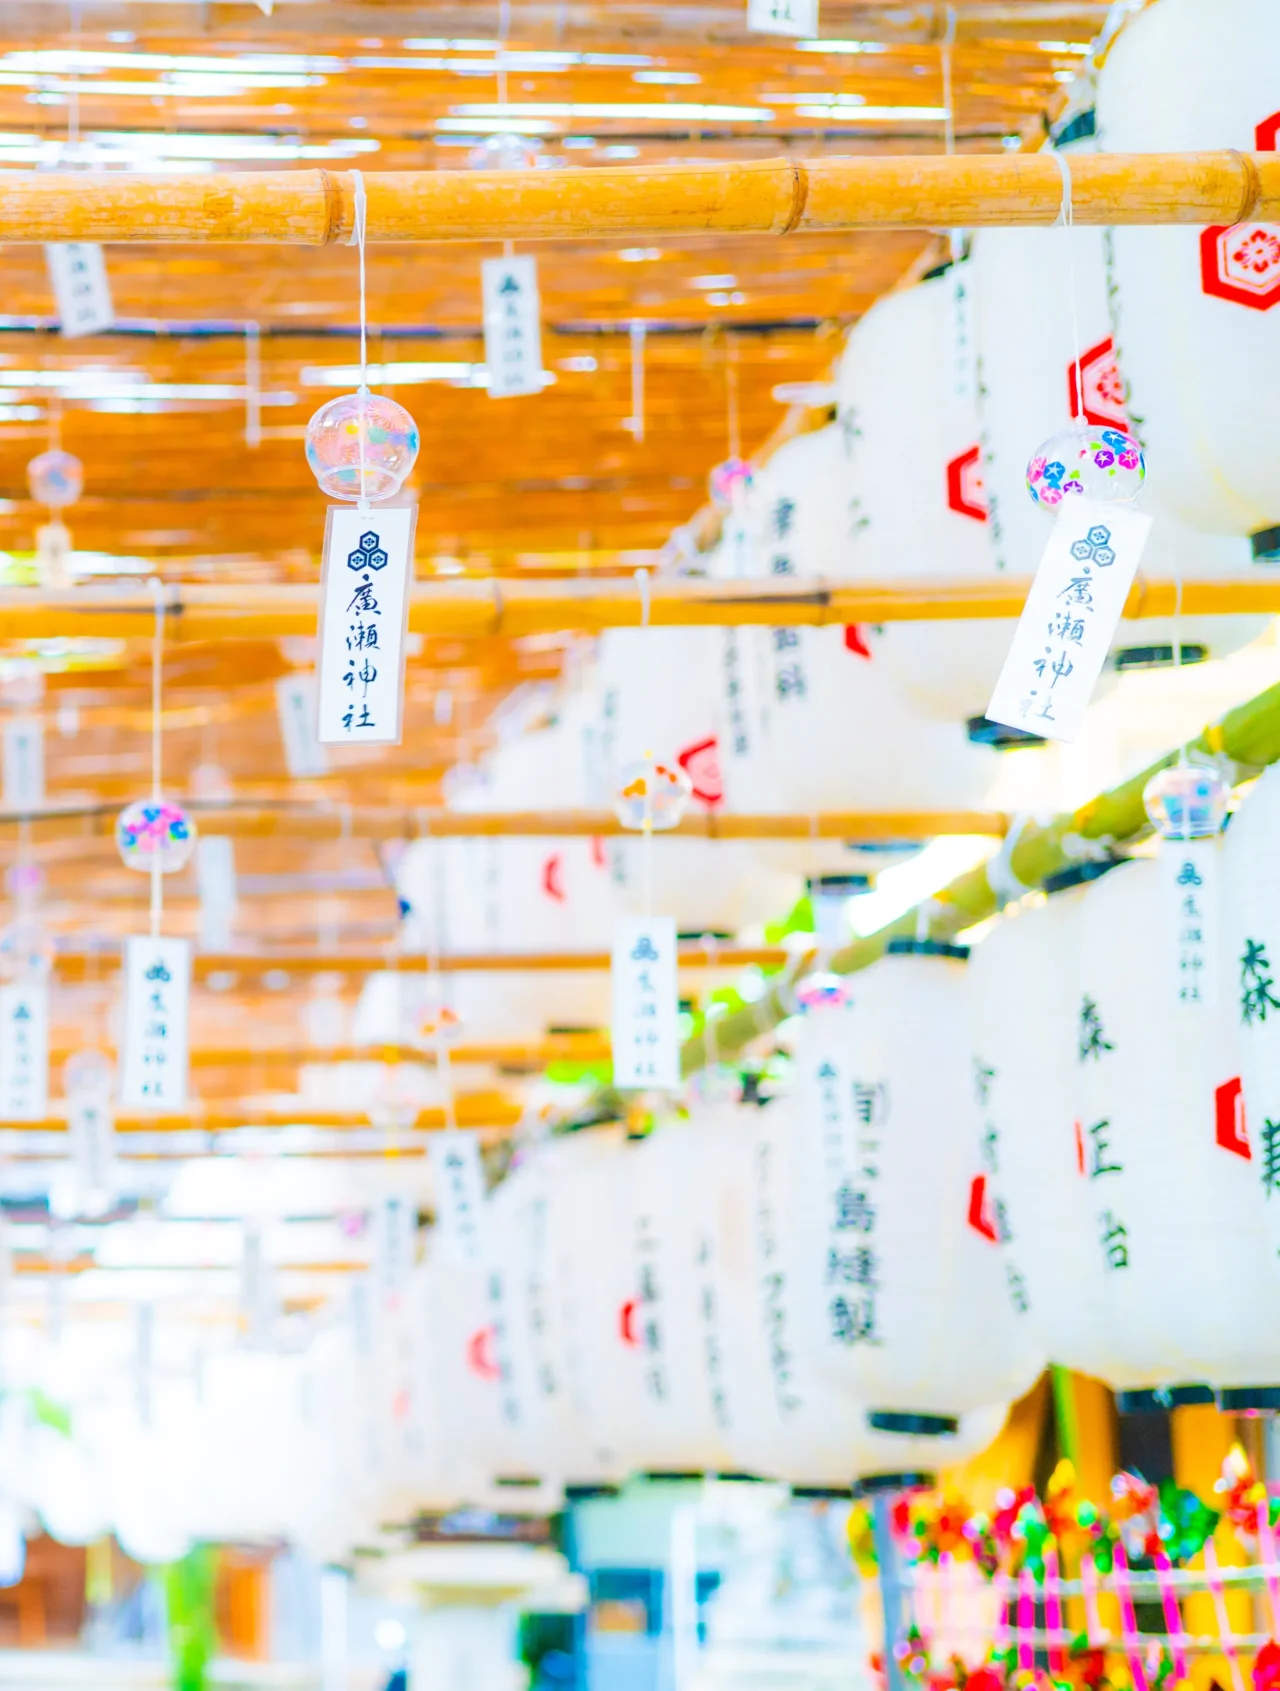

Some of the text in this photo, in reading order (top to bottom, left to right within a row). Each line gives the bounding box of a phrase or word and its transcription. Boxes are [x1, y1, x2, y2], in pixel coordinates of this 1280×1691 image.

[342, 574, 381, 733] 廣瀬神社
[1019, 567, 1094, 721] 廣瀬神社
